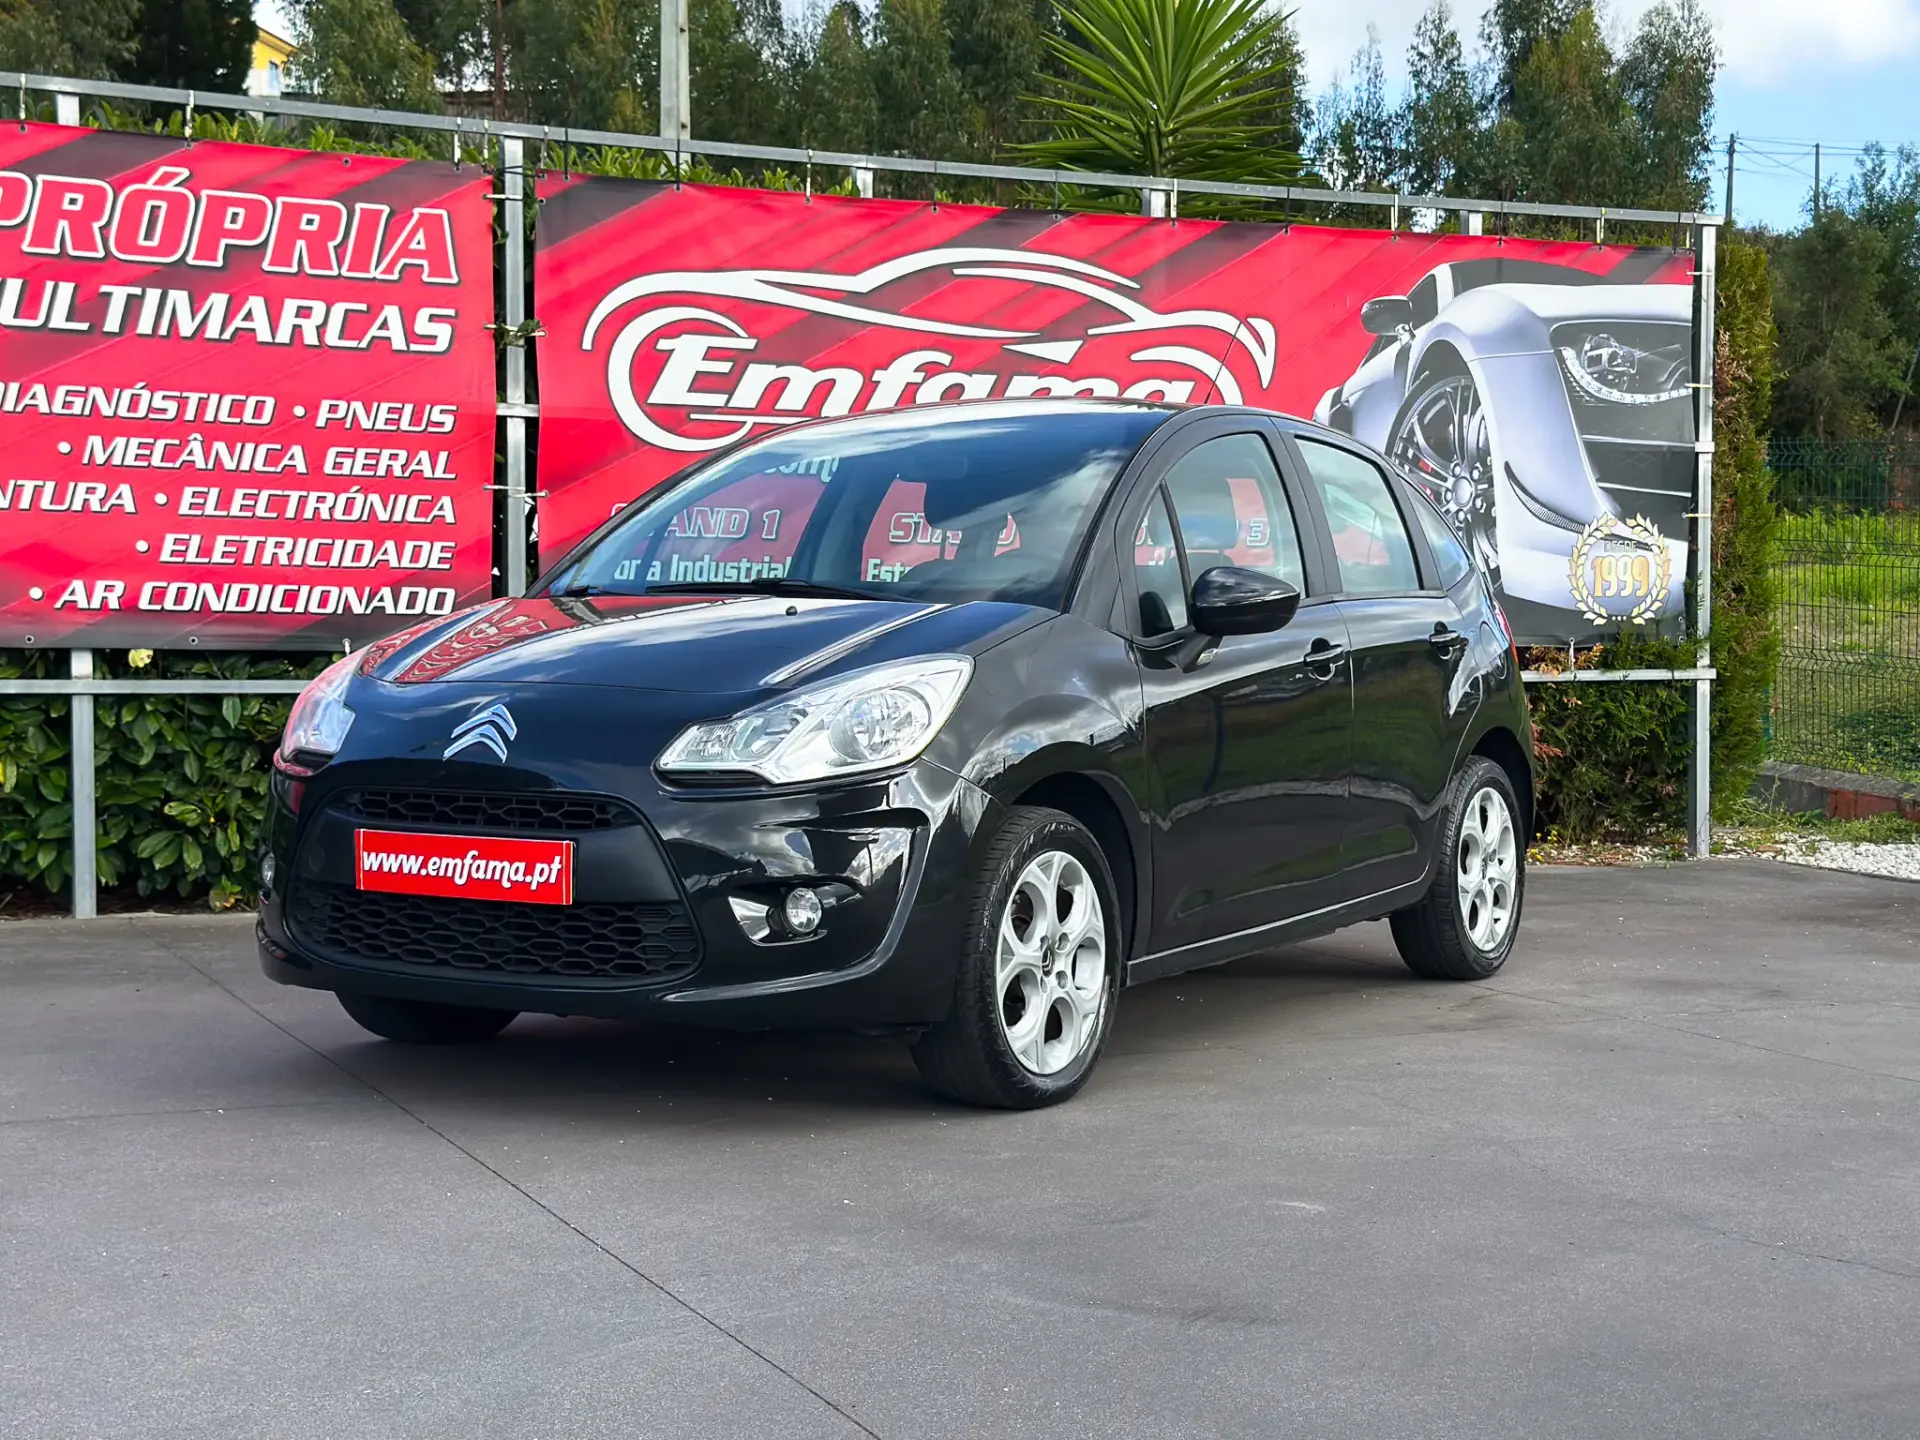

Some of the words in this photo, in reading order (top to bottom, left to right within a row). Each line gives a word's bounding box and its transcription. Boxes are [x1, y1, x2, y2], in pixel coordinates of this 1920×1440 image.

[0, 277, 456, 352] ULTIMARCAS
[0, 381, 276, 425] IAGNÓSTICO
[316, 400, 457, 433] PNEUS
[83, 433, 307, 474] MECÂNICA
[323, 447, 456, 479] GERAL
[178, 487, 456, 524] ELECTRÓNICA
[762, 508, 781, 540] 1
[159, 533, 456, 569] ELETRICIDADE
[1603, 540, 1638, 553] DESDE
[1591, 555, 1650, 597] 1999
[54, 579, 125, 609] AR
[138, 581, 456, 616] CONDICIONADO
[362, 850, 563, 891] www.emfama.pt
